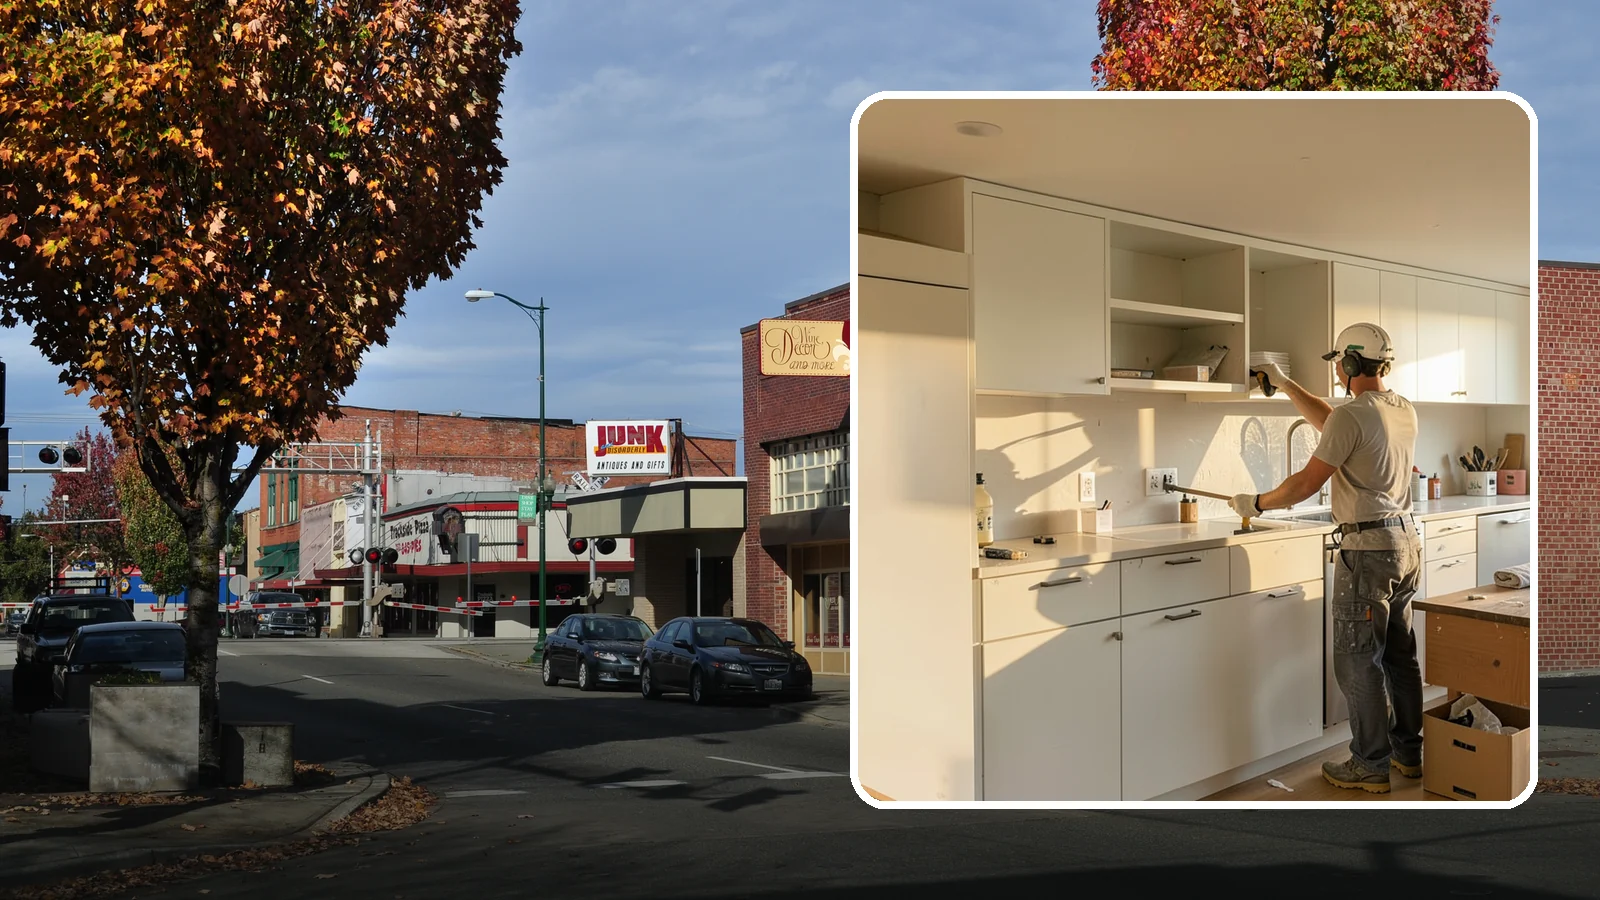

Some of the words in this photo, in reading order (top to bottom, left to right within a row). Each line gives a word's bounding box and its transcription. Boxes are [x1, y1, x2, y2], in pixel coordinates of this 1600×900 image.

[595, 425, 665, 457] JUNK
[597, 462, 628, 470] ANTIQUES
[631, 462, 644, 470] AND
[647, 461, 665, 470] GIFTS
[573, 474, 589, 492] RAIL
[590, 476, 608, 491] SING
[352, 498, 364, 510] CRO
[390, 522, 412, 539] Trackside
[414, 520, 428, 534] Pizza
